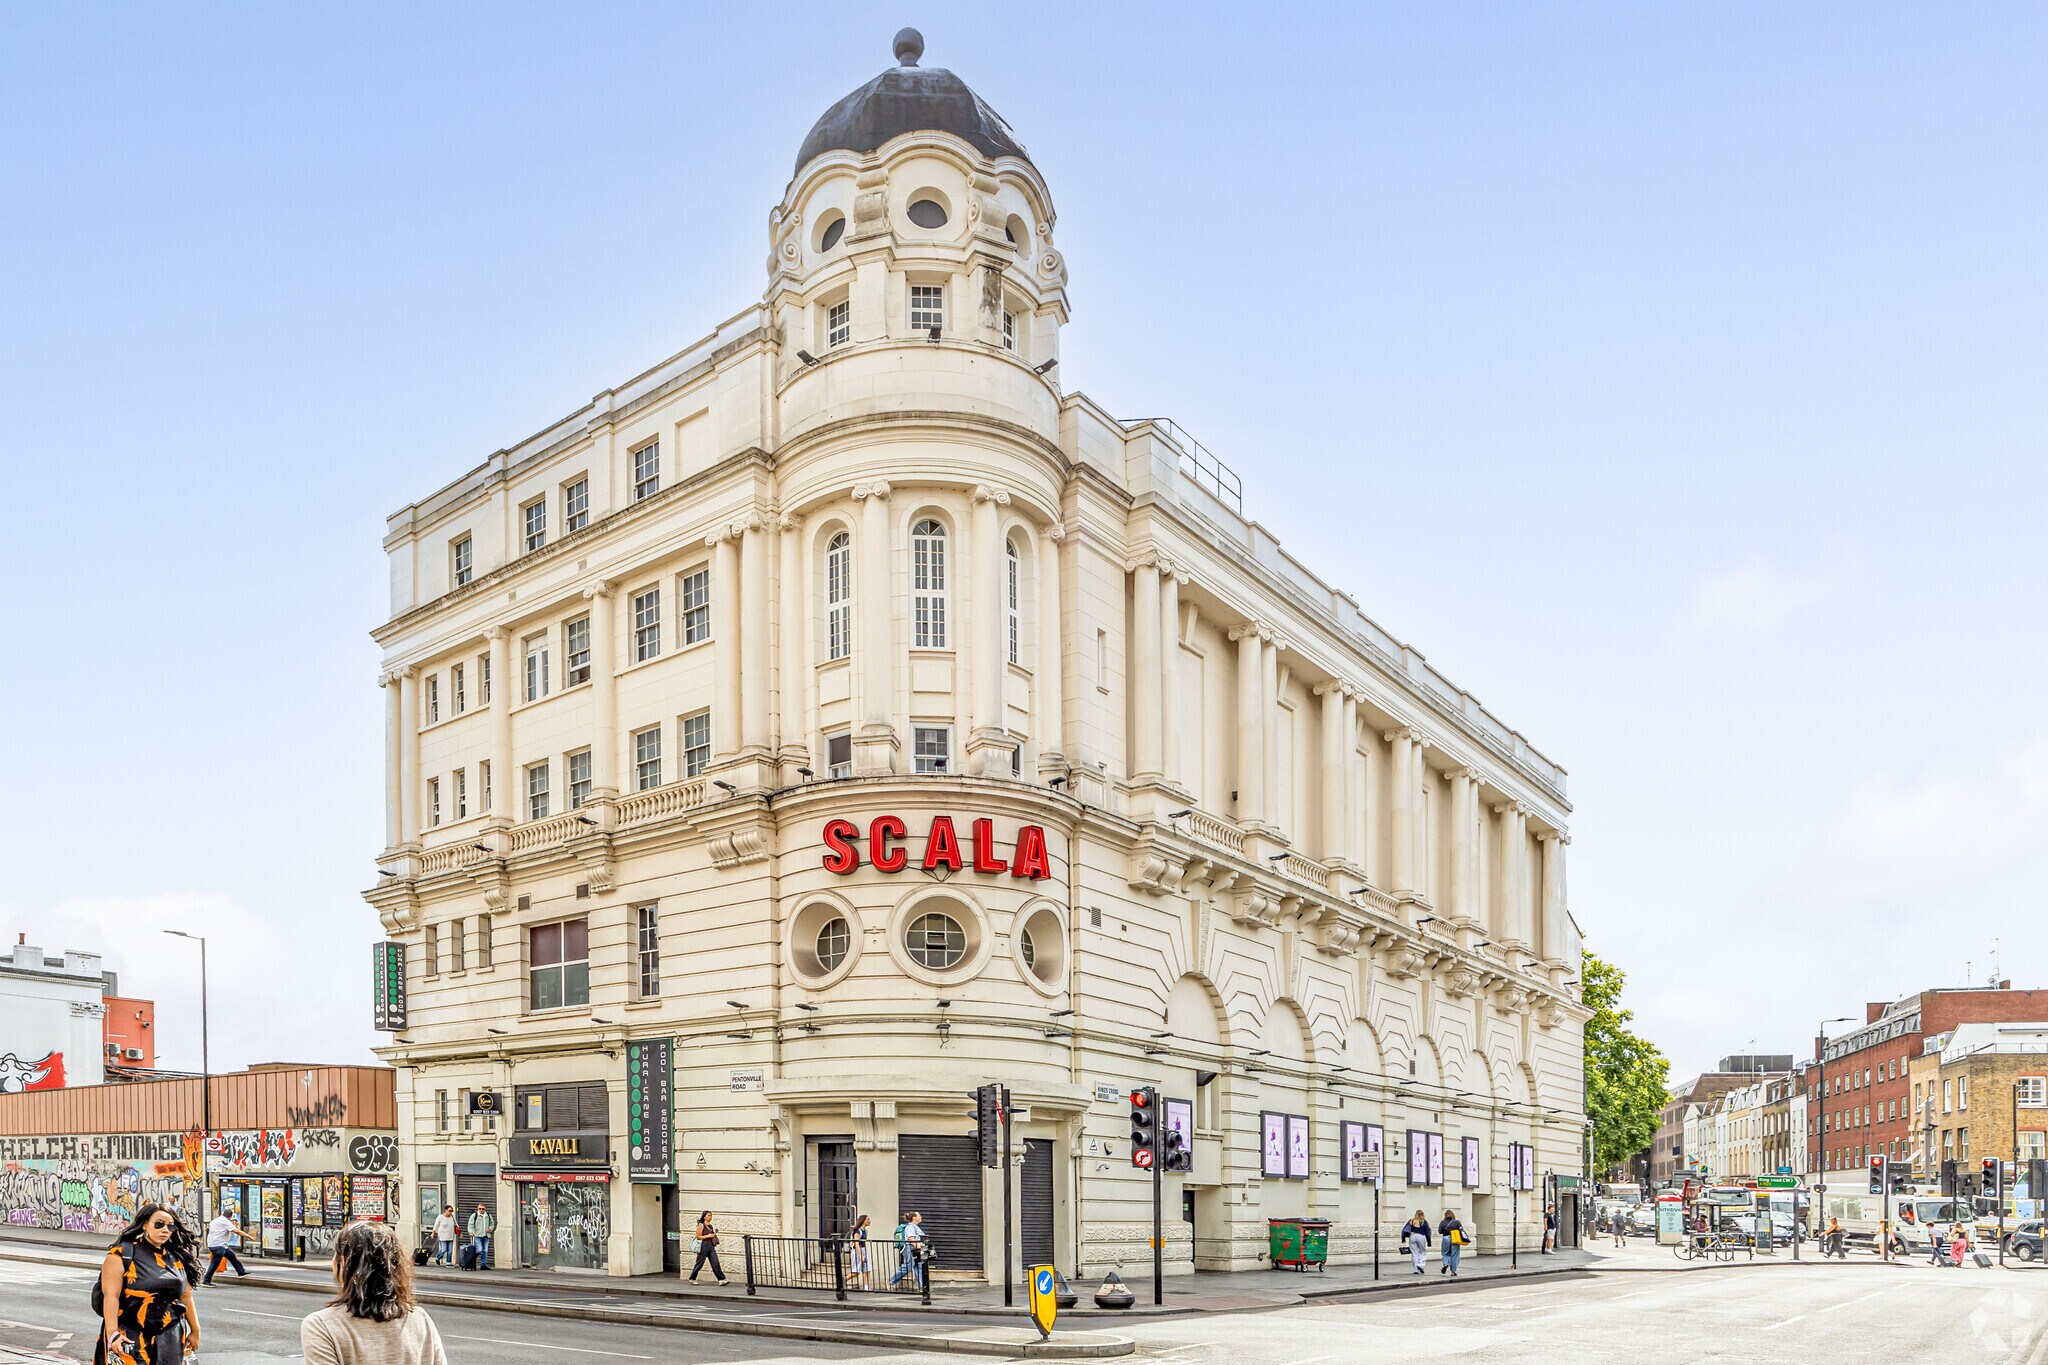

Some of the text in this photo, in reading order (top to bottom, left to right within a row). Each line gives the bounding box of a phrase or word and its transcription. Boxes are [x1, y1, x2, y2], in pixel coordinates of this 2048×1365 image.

[823, 815, 1052, 882] SCALA
[731, 1075, 762, 1083] PENTONVILLE
[642, 1045, 651, 1160] HURRICANE ROOM
[529, 1138, 579, 1155] KAVALI
